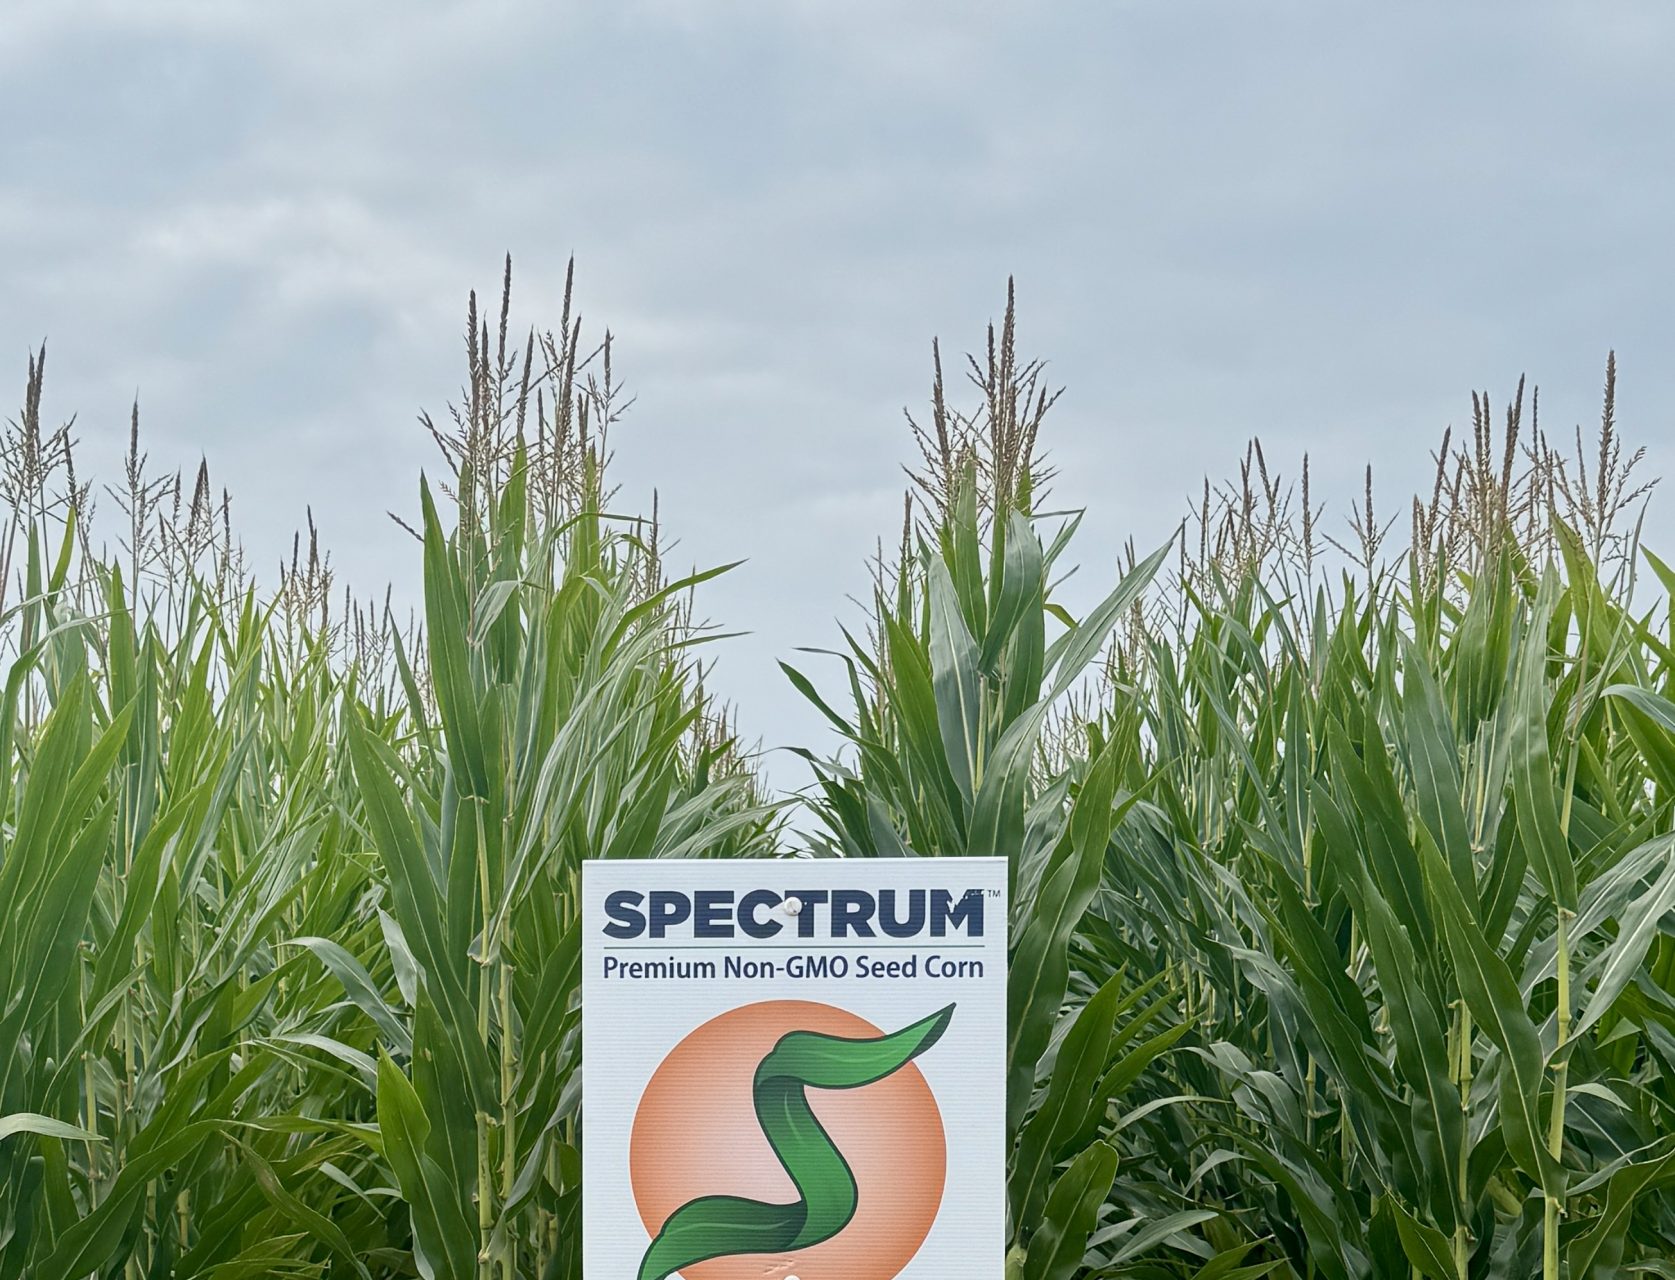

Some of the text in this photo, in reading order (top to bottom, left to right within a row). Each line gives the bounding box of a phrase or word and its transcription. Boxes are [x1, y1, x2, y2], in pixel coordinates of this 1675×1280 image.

[603, 954, 984, 979] Premium Non-GMO Seed Corn
